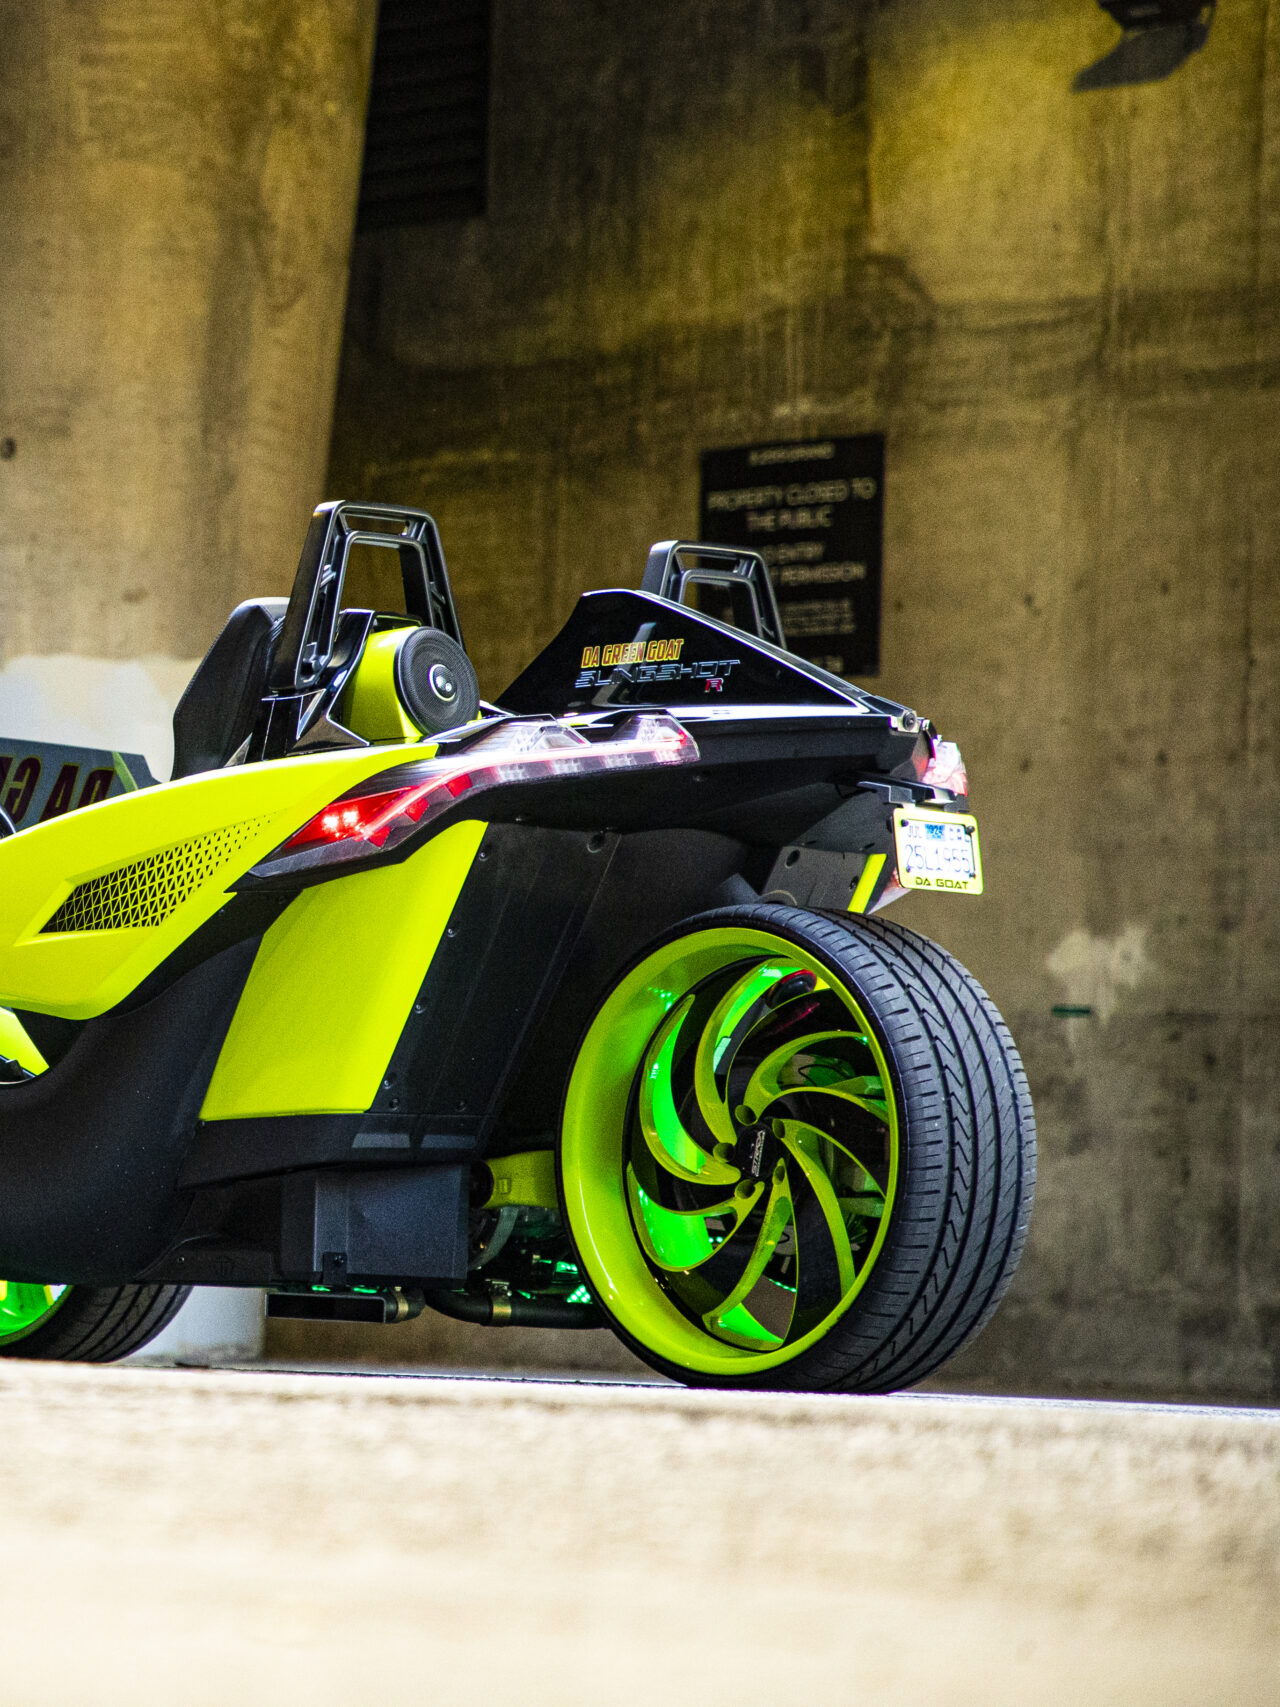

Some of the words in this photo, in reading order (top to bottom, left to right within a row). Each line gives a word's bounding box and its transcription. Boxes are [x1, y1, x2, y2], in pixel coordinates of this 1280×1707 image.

[785, 480, 849, 505] CLOSED
[852, 477, 876, 499] TO
[581, 646, 600, 668] DA
[602, 642, 646, 666] GREEN
[646, 638, 684, 661] GOAT
[575, 660, 740, 688] SLINGSHOT
[915, 877, 931, 886] DA
[936, 879, 969, 890] GOAT
